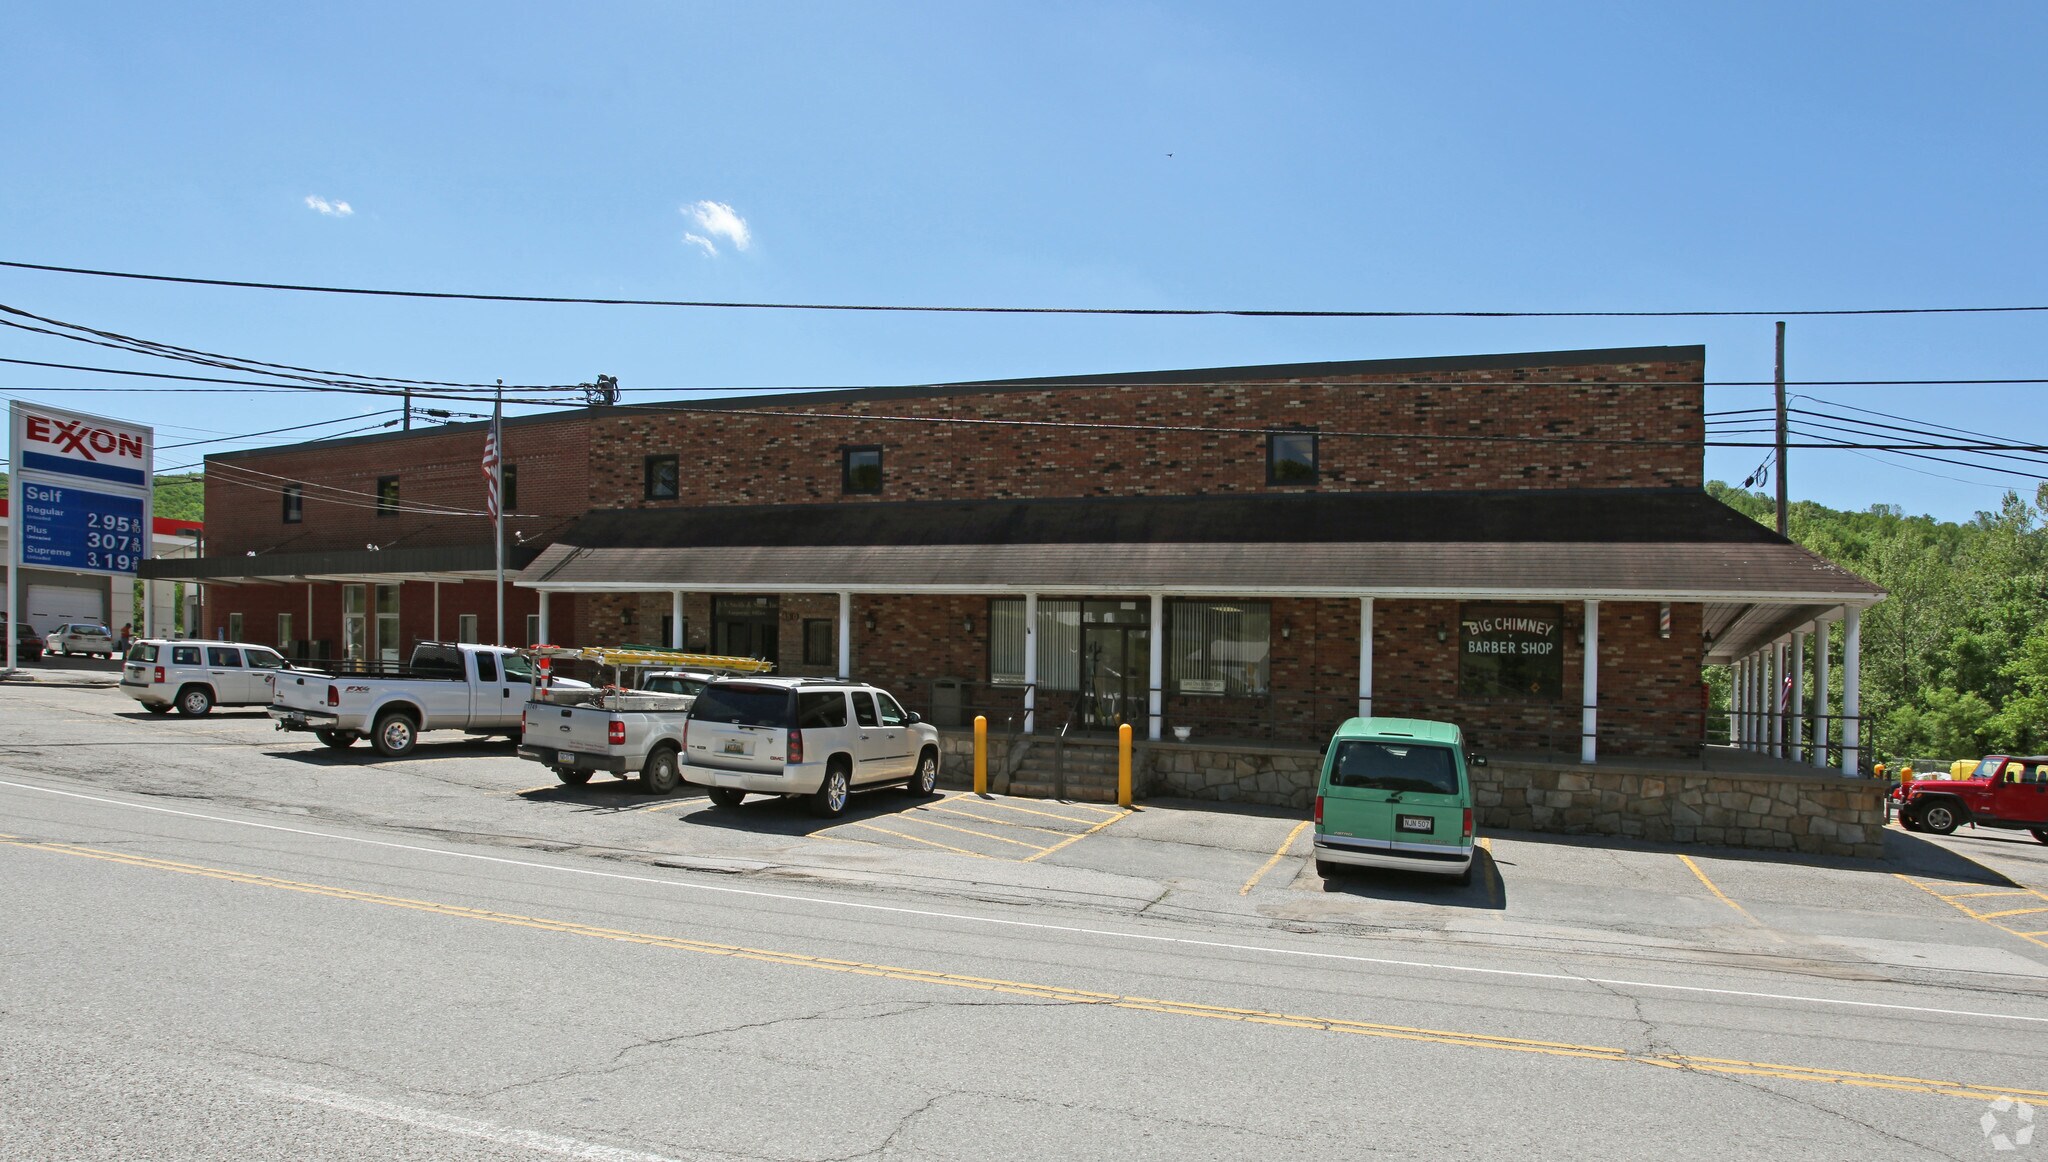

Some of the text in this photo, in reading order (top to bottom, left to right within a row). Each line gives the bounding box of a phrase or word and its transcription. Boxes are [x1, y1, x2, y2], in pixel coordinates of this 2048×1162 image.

[27, 415, 142, 461] EXXON
[26, 486, 62, 503] Self
[26, 504, 64, 516] Regular
[26, 525, 48, 535] Plus
[87, 512, 129, 532] 2.95
[27, 545, 71, 557] Supreme
[87, 551, 130, 570] 3.19
[1468, 618, 1553, 636] BIG CHIMNEY
[1468, 641, 1553, 655] BARBER SHOP
